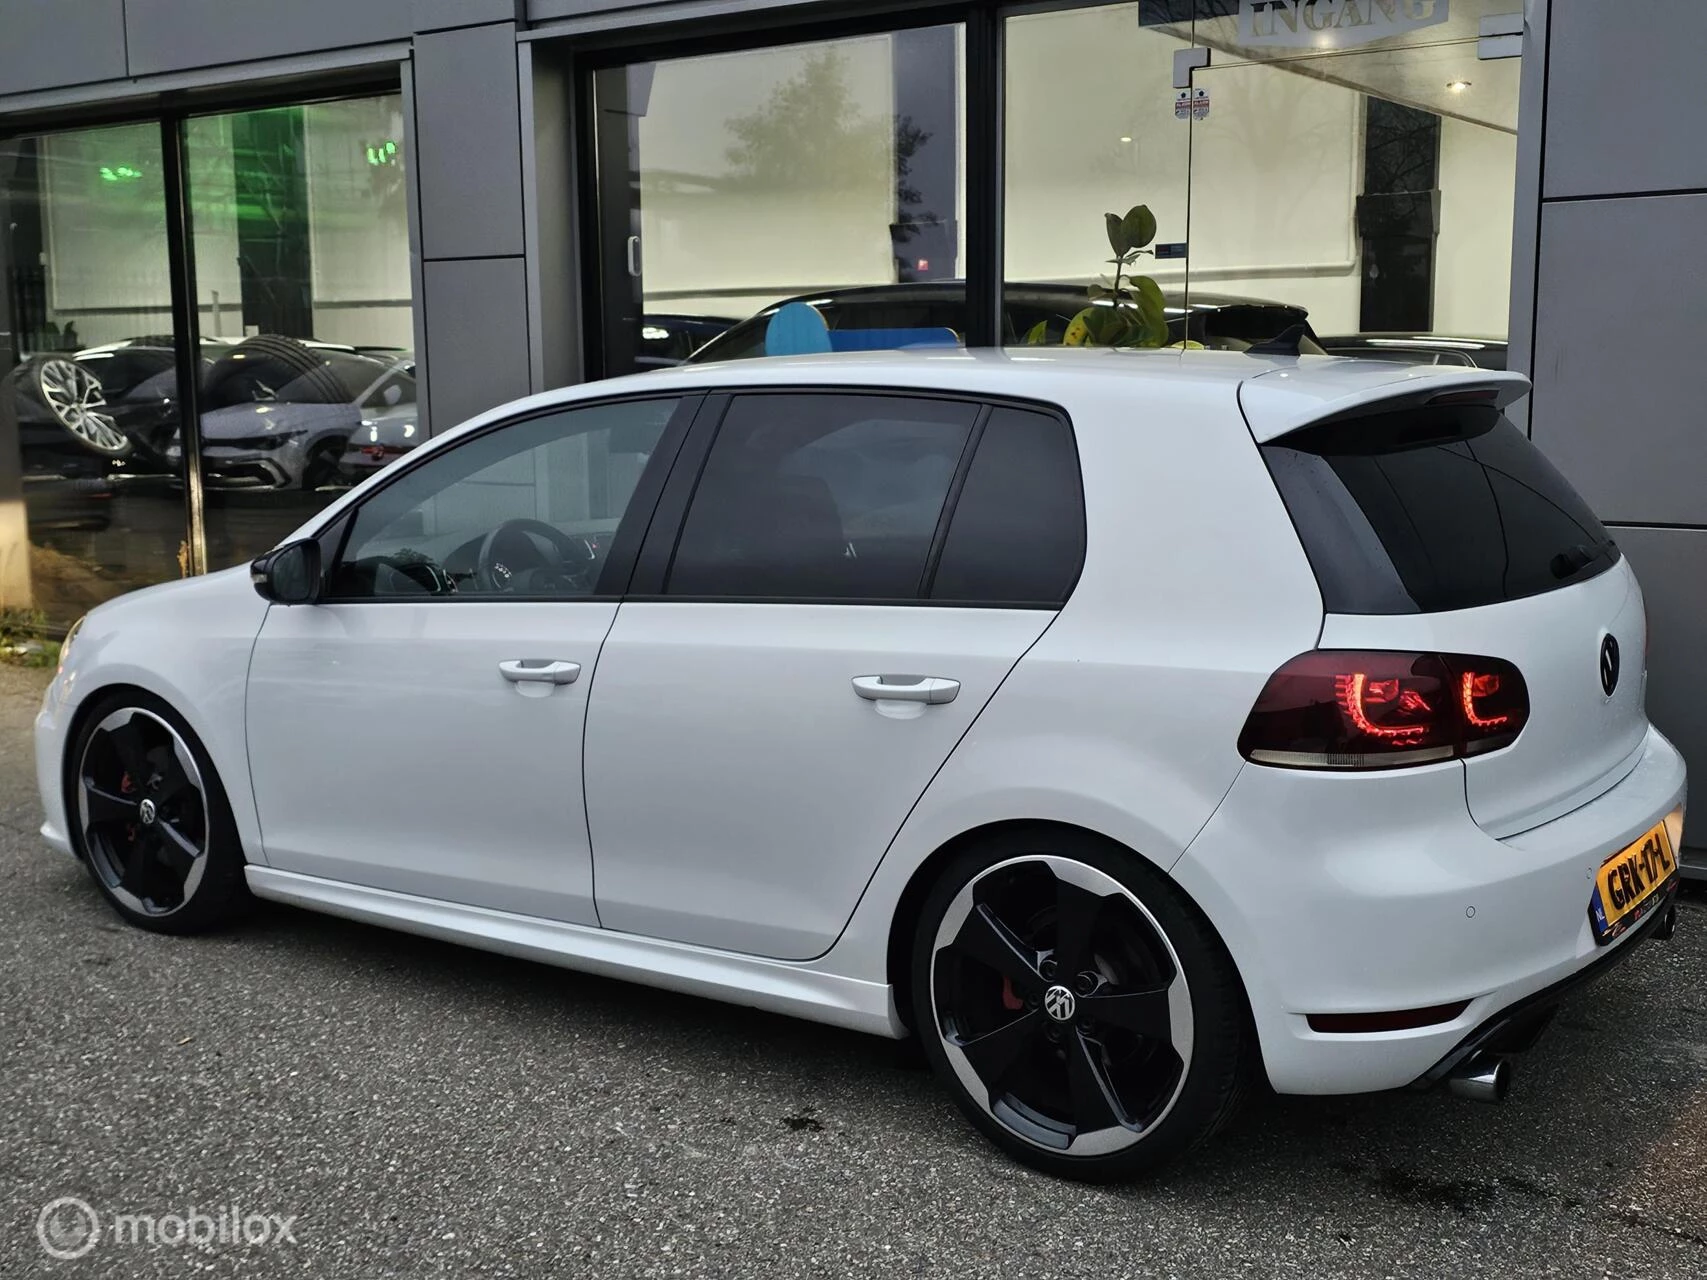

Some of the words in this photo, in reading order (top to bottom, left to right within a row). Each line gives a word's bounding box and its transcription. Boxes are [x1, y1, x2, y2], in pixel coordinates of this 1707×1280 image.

[1250, 0, 1436, 37] INGANG
[1607, 833, 1671, 910] GRK-17-L
[1595, 907, 1606, 922] NL
